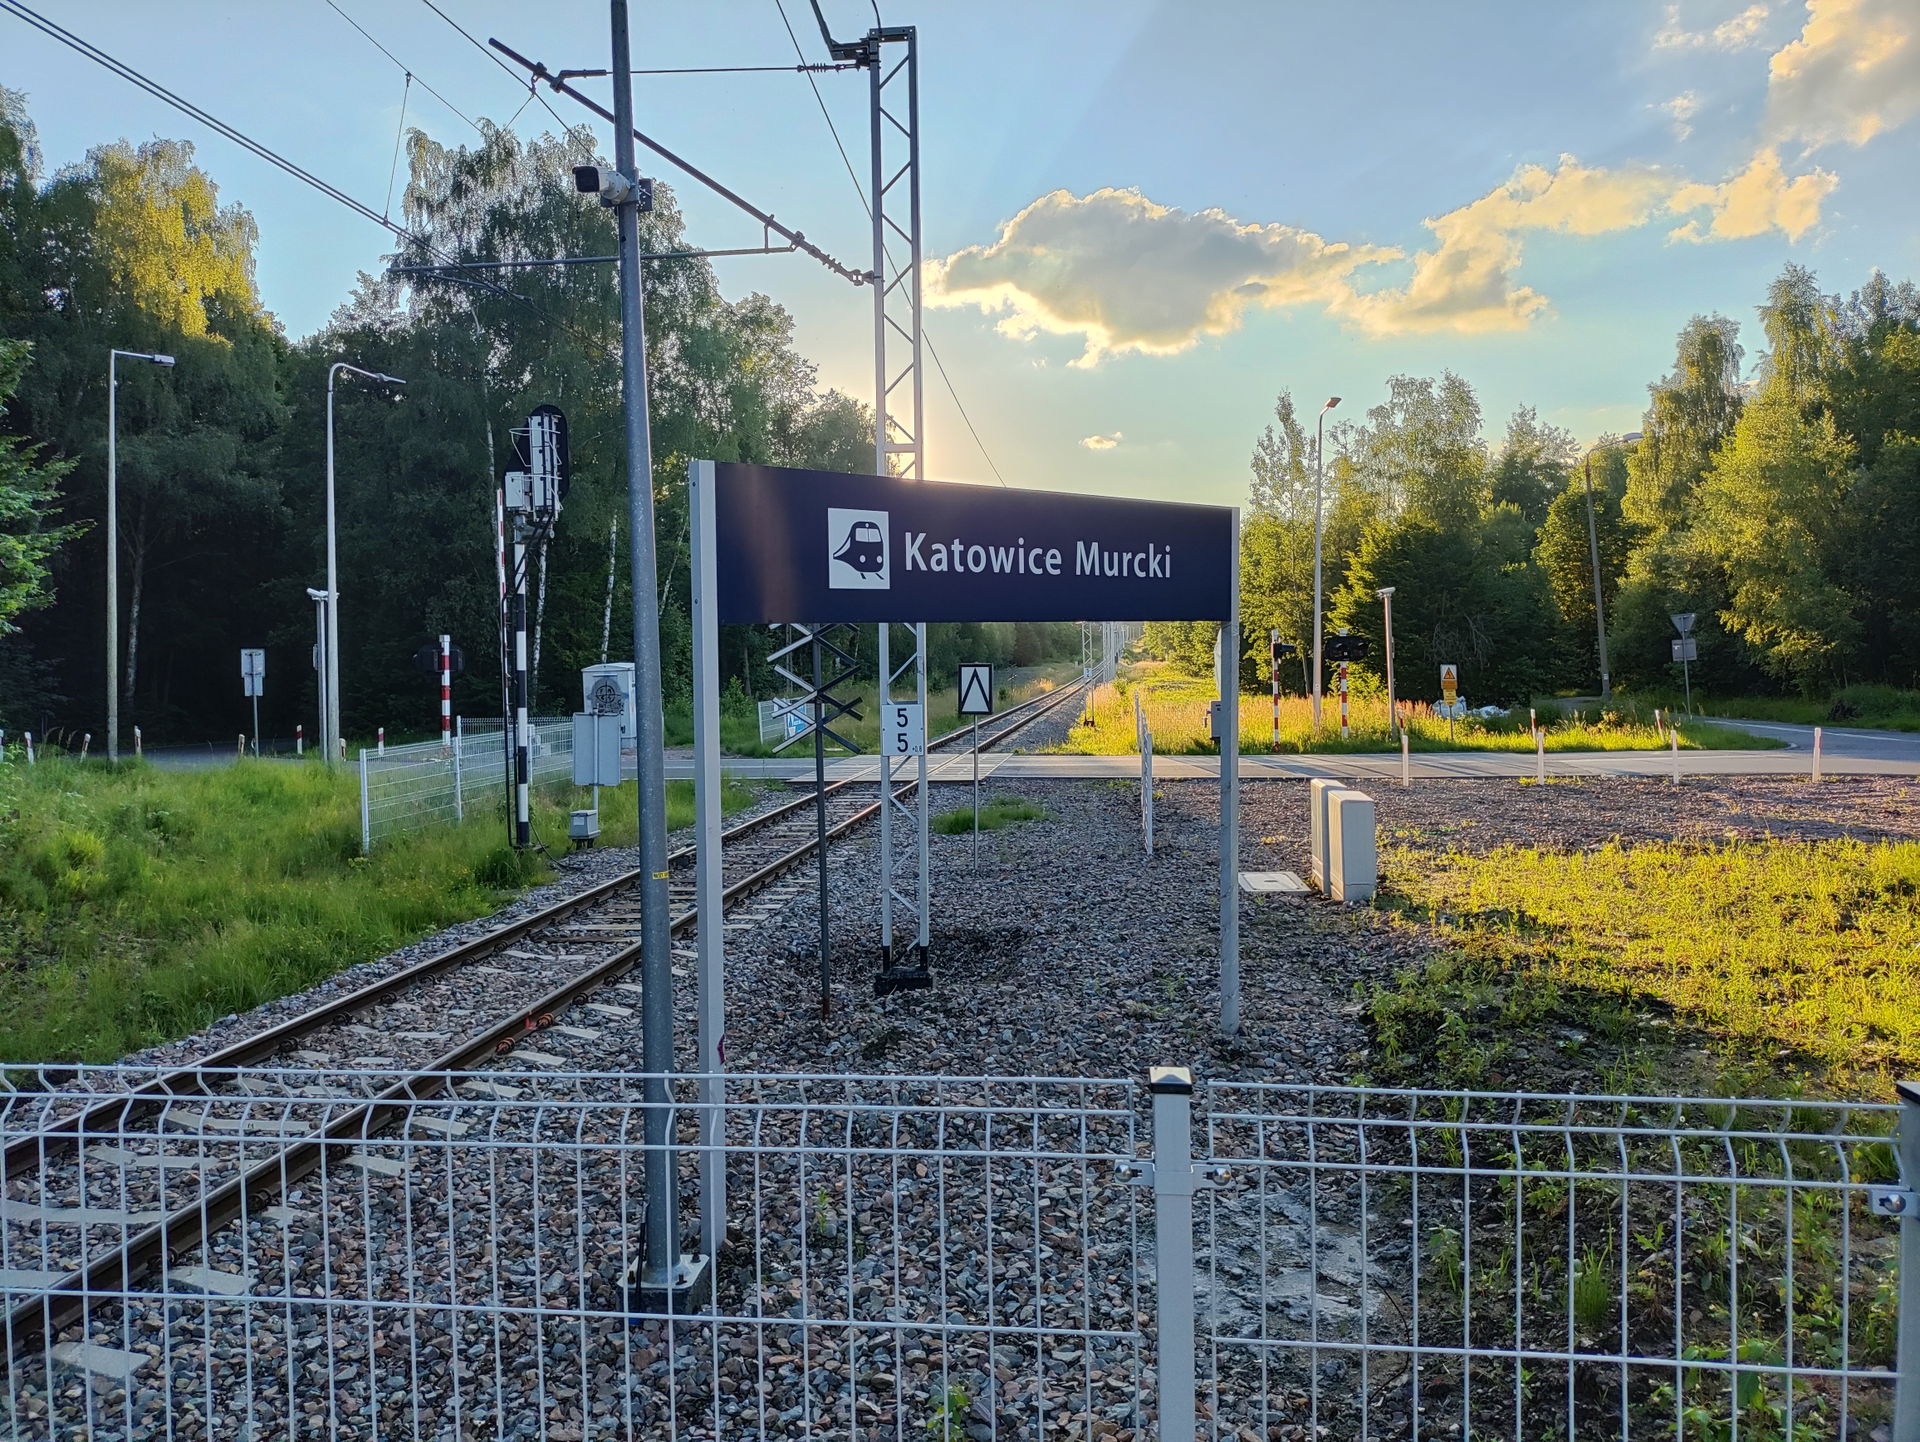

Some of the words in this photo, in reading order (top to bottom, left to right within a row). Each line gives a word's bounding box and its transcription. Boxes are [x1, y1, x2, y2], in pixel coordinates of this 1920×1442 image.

[905, 532, 1062, 575] Katowice
[1075, 541, 1171, 578] Murcki
[896, 707, 909, 728] 5
[897, 732, 909, 753] 5
